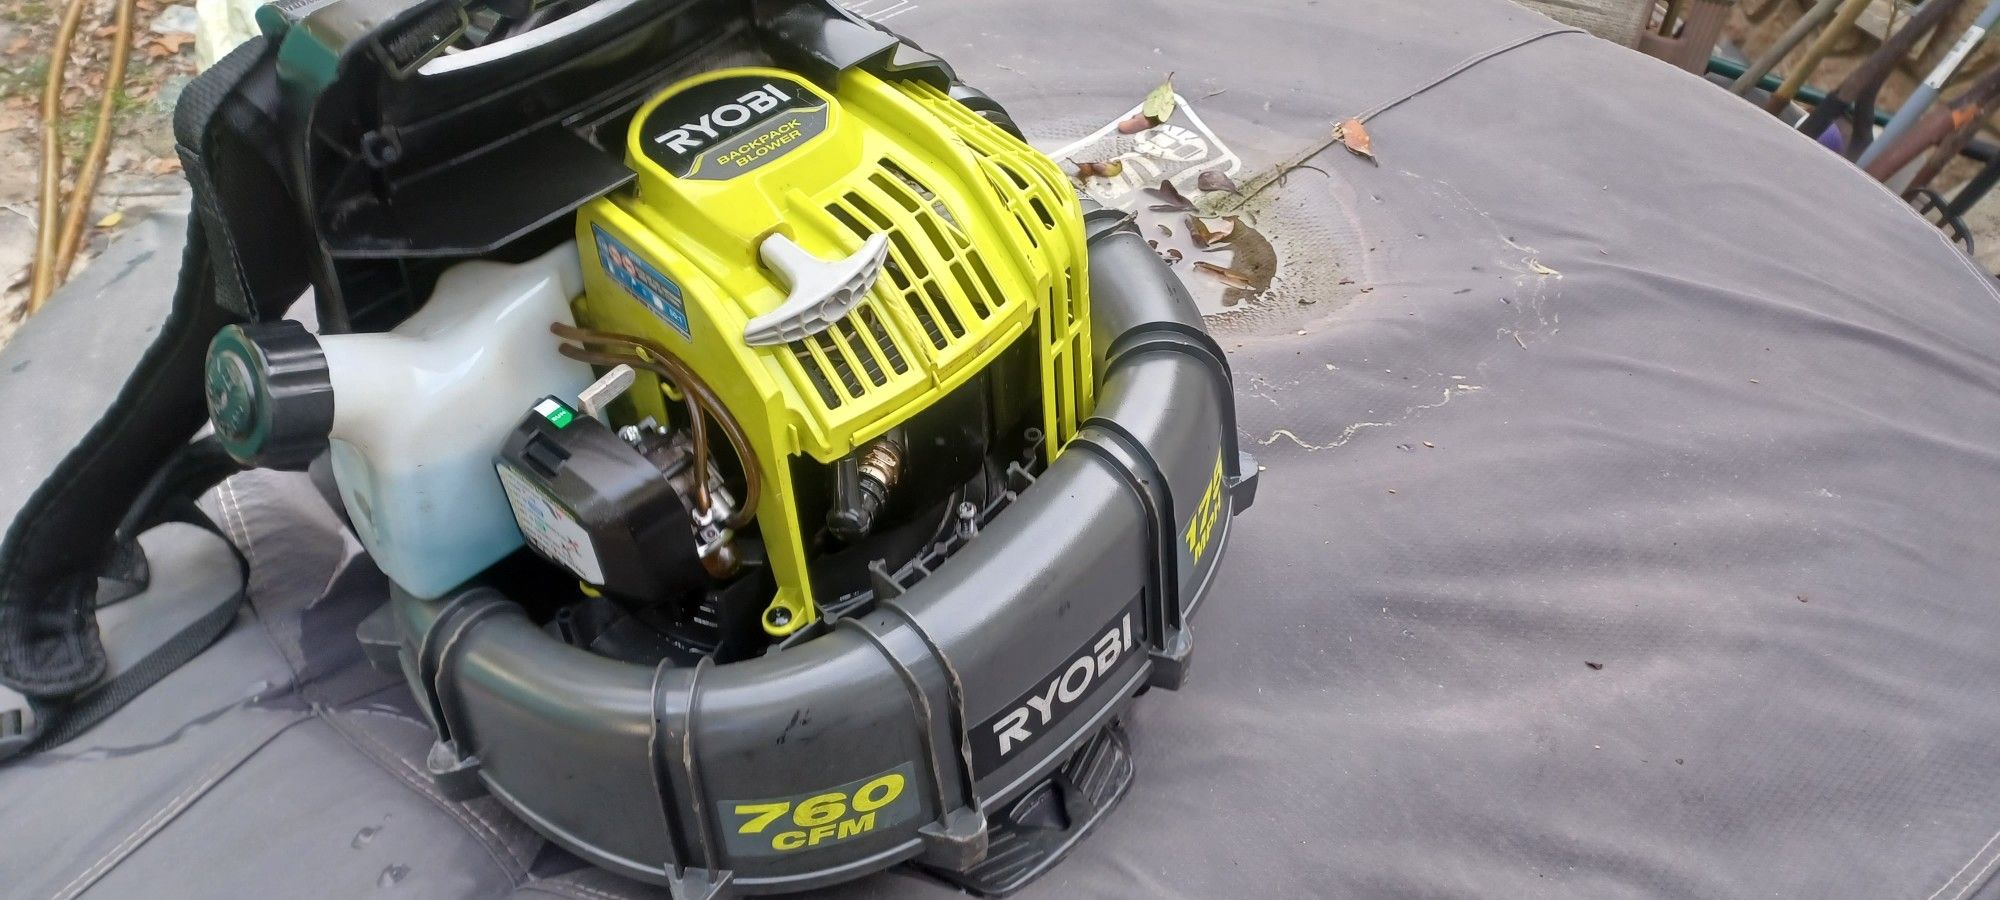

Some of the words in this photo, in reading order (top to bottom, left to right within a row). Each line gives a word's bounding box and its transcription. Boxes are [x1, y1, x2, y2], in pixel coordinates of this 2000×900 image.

[654, 83, 792, 155] RYOBI
[716, 118, 802, 166] BACKPACK
[735, 129, 802, 167] BLOWER
[1194, 489, 1222, 567] MPH
[992, 612, 1132, 757] RYOBI
[734, 773, 905, 835] 760
[771, 811, 878, 853] CFM
